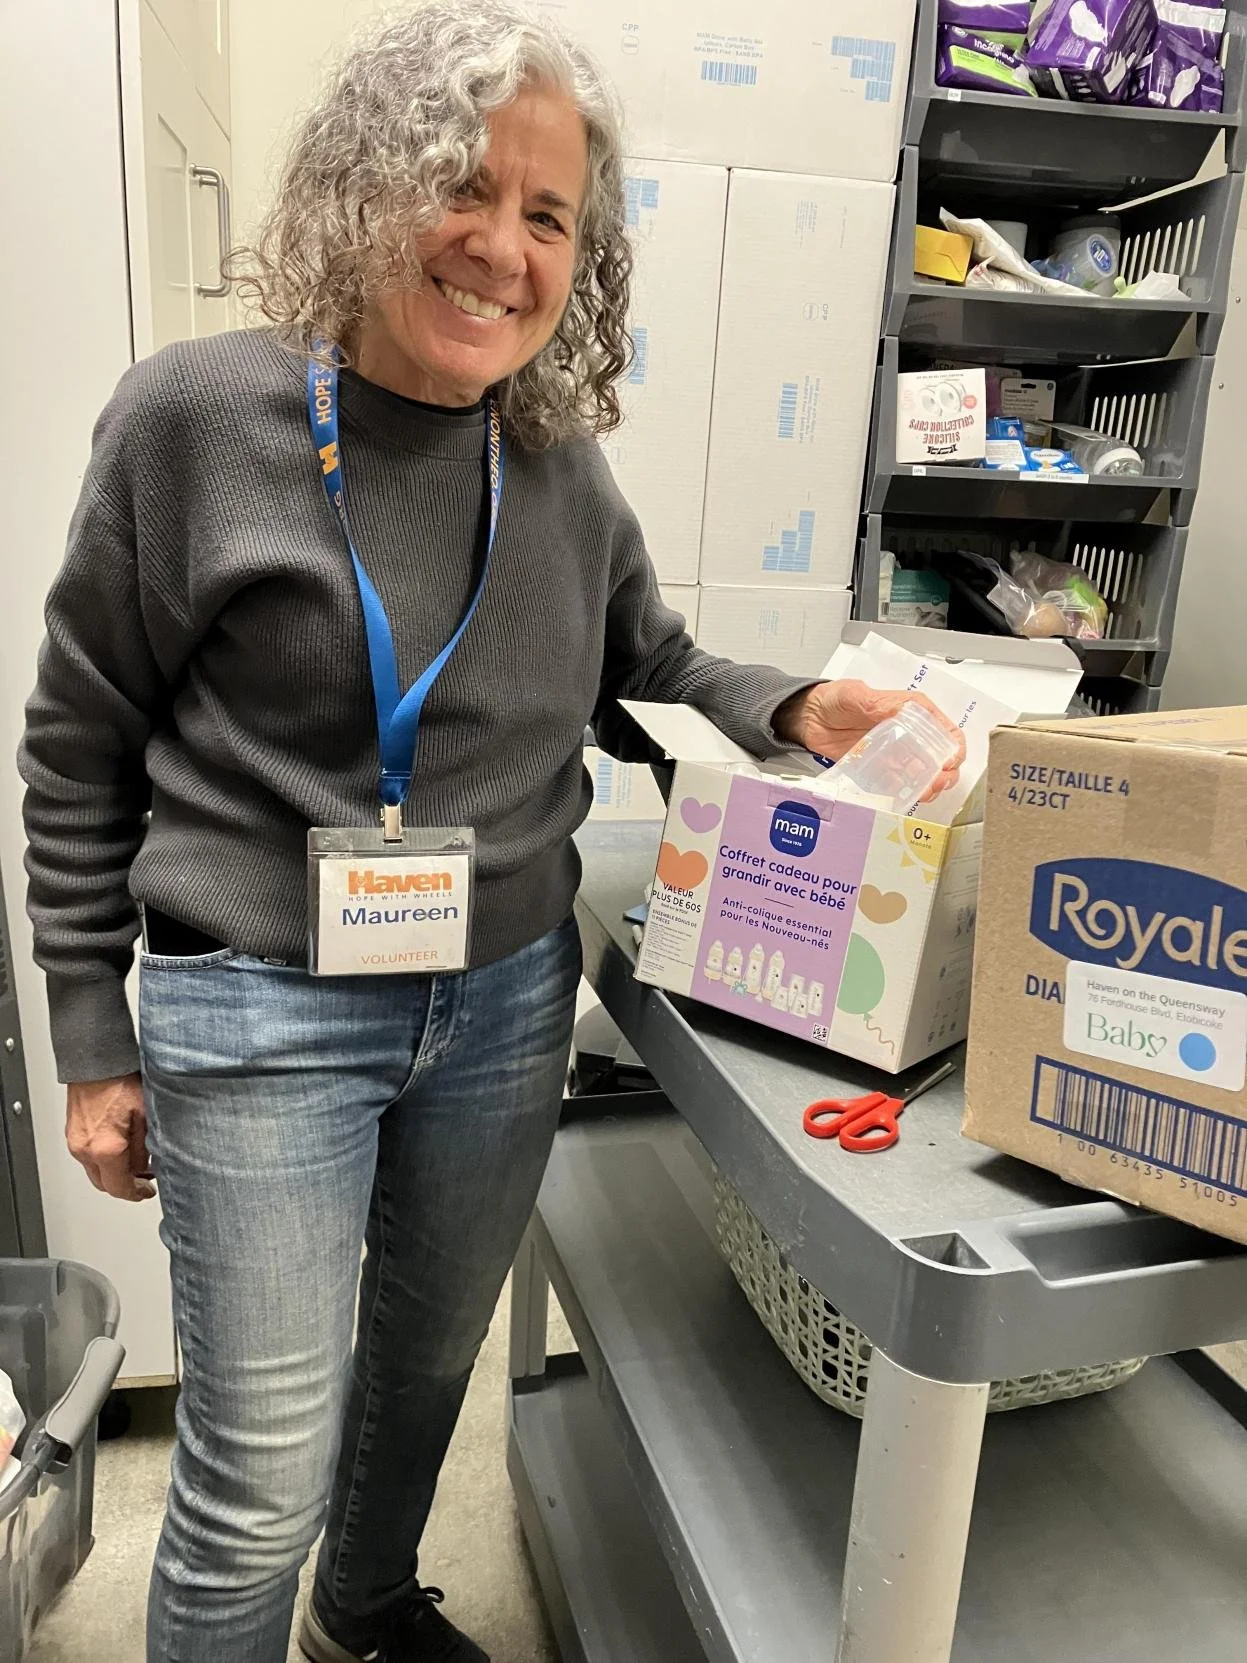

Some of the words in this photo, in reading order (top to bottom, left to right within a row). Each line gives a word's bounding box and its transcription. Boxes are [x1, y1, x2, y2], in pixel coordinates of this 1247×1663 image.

[315, 378, 332, 424] HOPE
[908, 418, 929, 431] CUPS
[930, 414, 975, 433] COLLECTION
[922, 431, 961, 445] SILICONE
[914, 663, 929, 683] Set
[957, 713, 970, 729] our
[1010, 763, 1113, 793] SIZE/TAILLE
[1118, 780, 1130, 797] 4
[1008, 786, 1070, 810] 4/23CT
[775, 818, 814, 839] mam
[913, 827, 932, 843] 0+
[720, 845, 766, 868] Coffret
[768, 861, 820, 884] cadeau
[822, 877, 857, 895] pour
[348, 870, 453, 895] Haven
[663, 883, 694, 899] VALEUR
[722, 865, 771, 887] grandir
[774, 881, 807, 899] avec
[809, 889, 846, 911] bébé
[652, 890, 671, 903] PLUS
[672, 896, 684, 907] DE
[342, 905, 458, 926] Maureen
[722, 897, 783, 923] Anti-colique
[785, 918, 832, 938] essential
[720, 909, 743, 922] pour
[745, 915, 759, 927] les
[761, 922, 829, 950] Nouveau-nés
[361, 950, 438, 965] VOLUNTEER
[1025, 974, 1066, 1005] DIA
[1087, 979, 1120, 995] Haven
[1123, 988, 1136, 998] on
[1138, 988, 1157, 1003] the
[1159, 993, 1226, 1018] Queensway
[1176, 1012, 1224, 1030] Etobicoke
[1087, 1012, 1168, 1058] Baby
[1057, 1133, 1064, 1145] 1
[1077, 1143, 1097, 1157] 00
[1110, 1150, 1164, 1181] 63435
[1179, 1177, 1238, 1207] 51005
